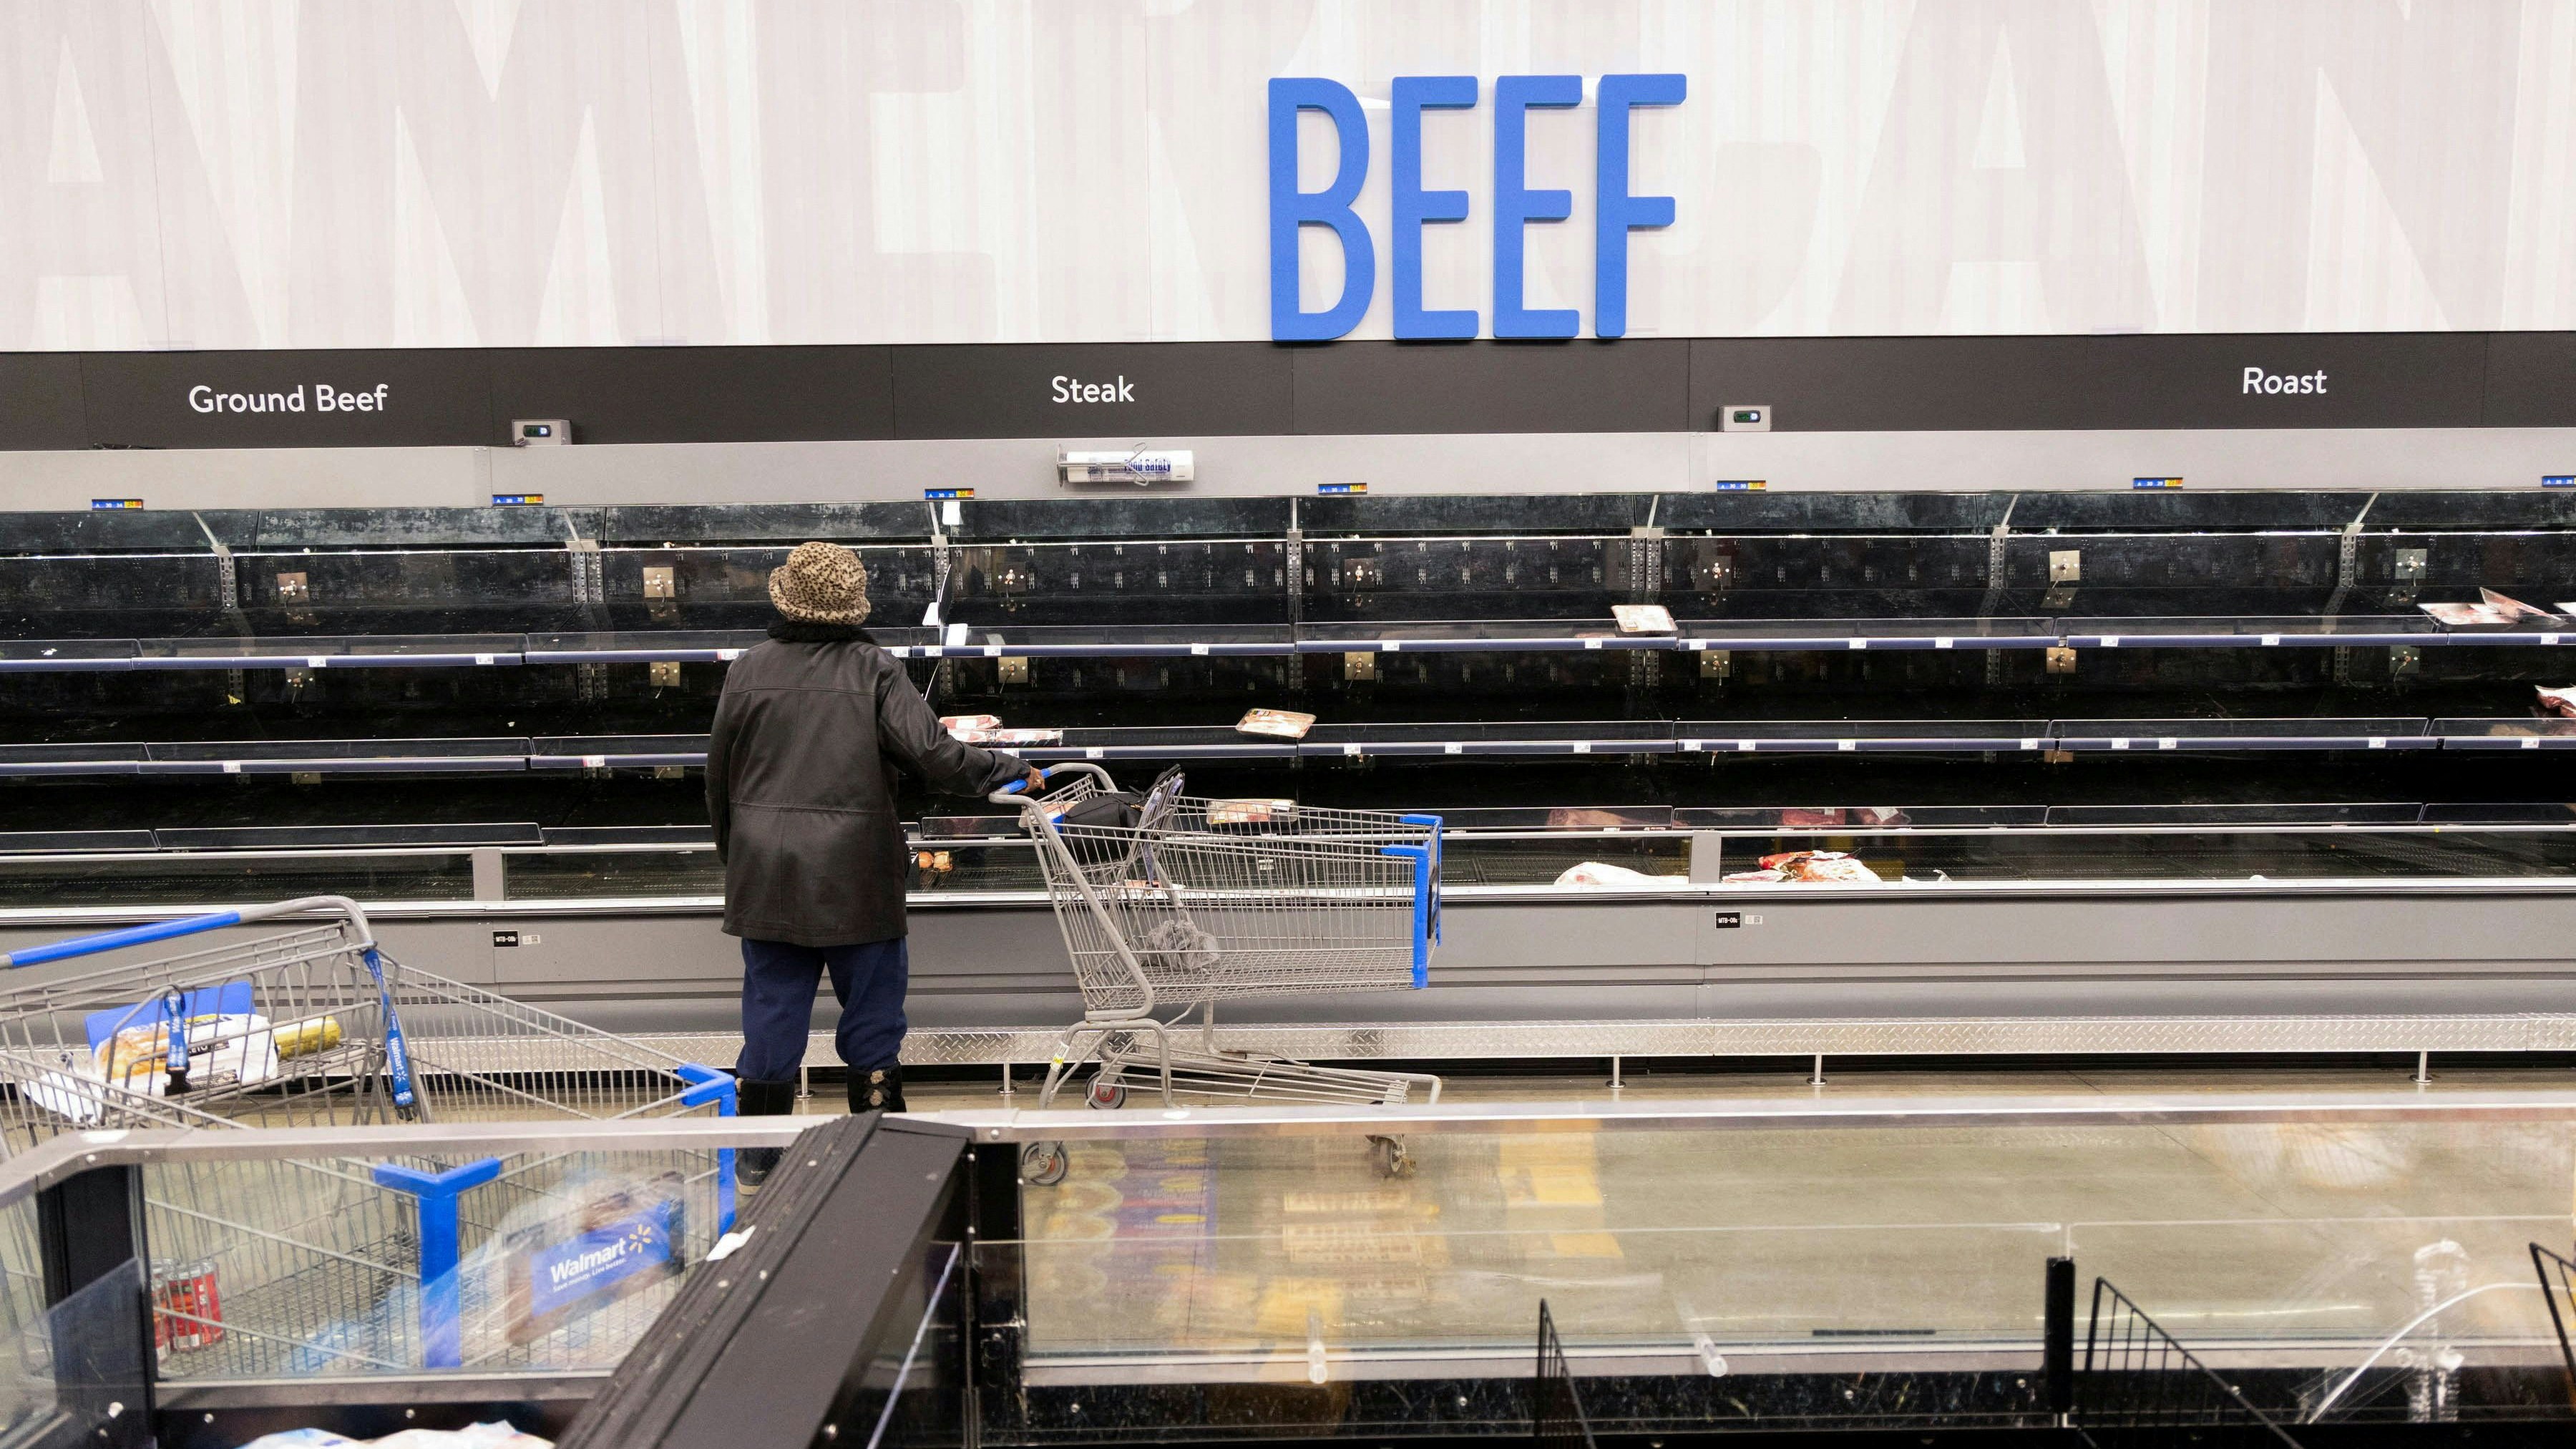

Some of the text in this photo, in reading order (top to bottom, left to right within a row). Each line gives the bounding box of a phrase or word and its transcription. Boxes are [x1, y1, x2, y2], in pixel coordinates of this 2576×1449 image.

[1269, 74, 1687, 341] BEEF
[1052, 375, 1135, 403] Steak
[2243, 367, 2328, 394] Roast
[189, 384, 389, 413] Ground Beef
[1145, 459, 1171, 472] Safety
[390, 1038, 404, 1071] Walmart
[550, 1238, 626, 1283] Walmart
[592, 1266, 605, 1276] Live
